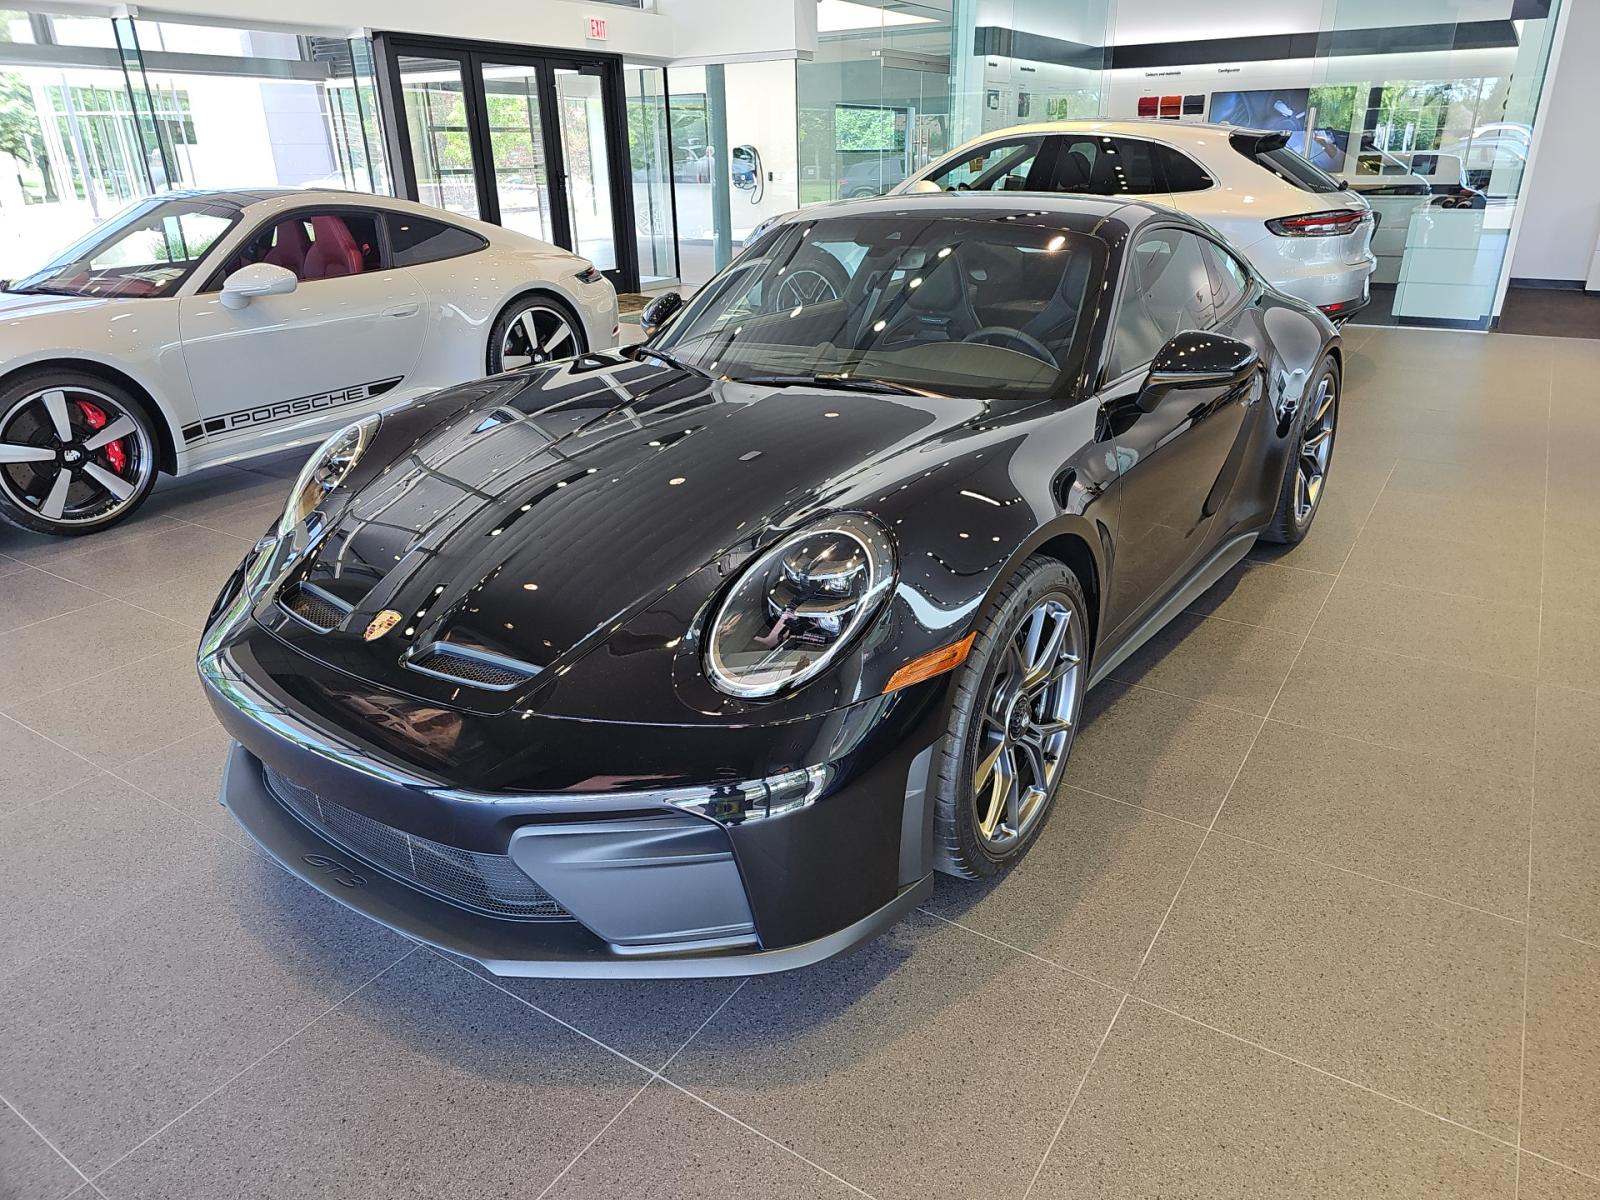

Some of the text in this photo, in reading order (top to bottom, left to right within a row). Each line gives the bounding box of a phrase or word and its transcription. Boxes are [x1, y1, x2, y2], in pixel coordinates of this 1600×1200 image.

[591, 19, 605, 38] EXIT
[230, 386, 365, 428] PORSCHE
[301, 852, 368, 889] GT3
